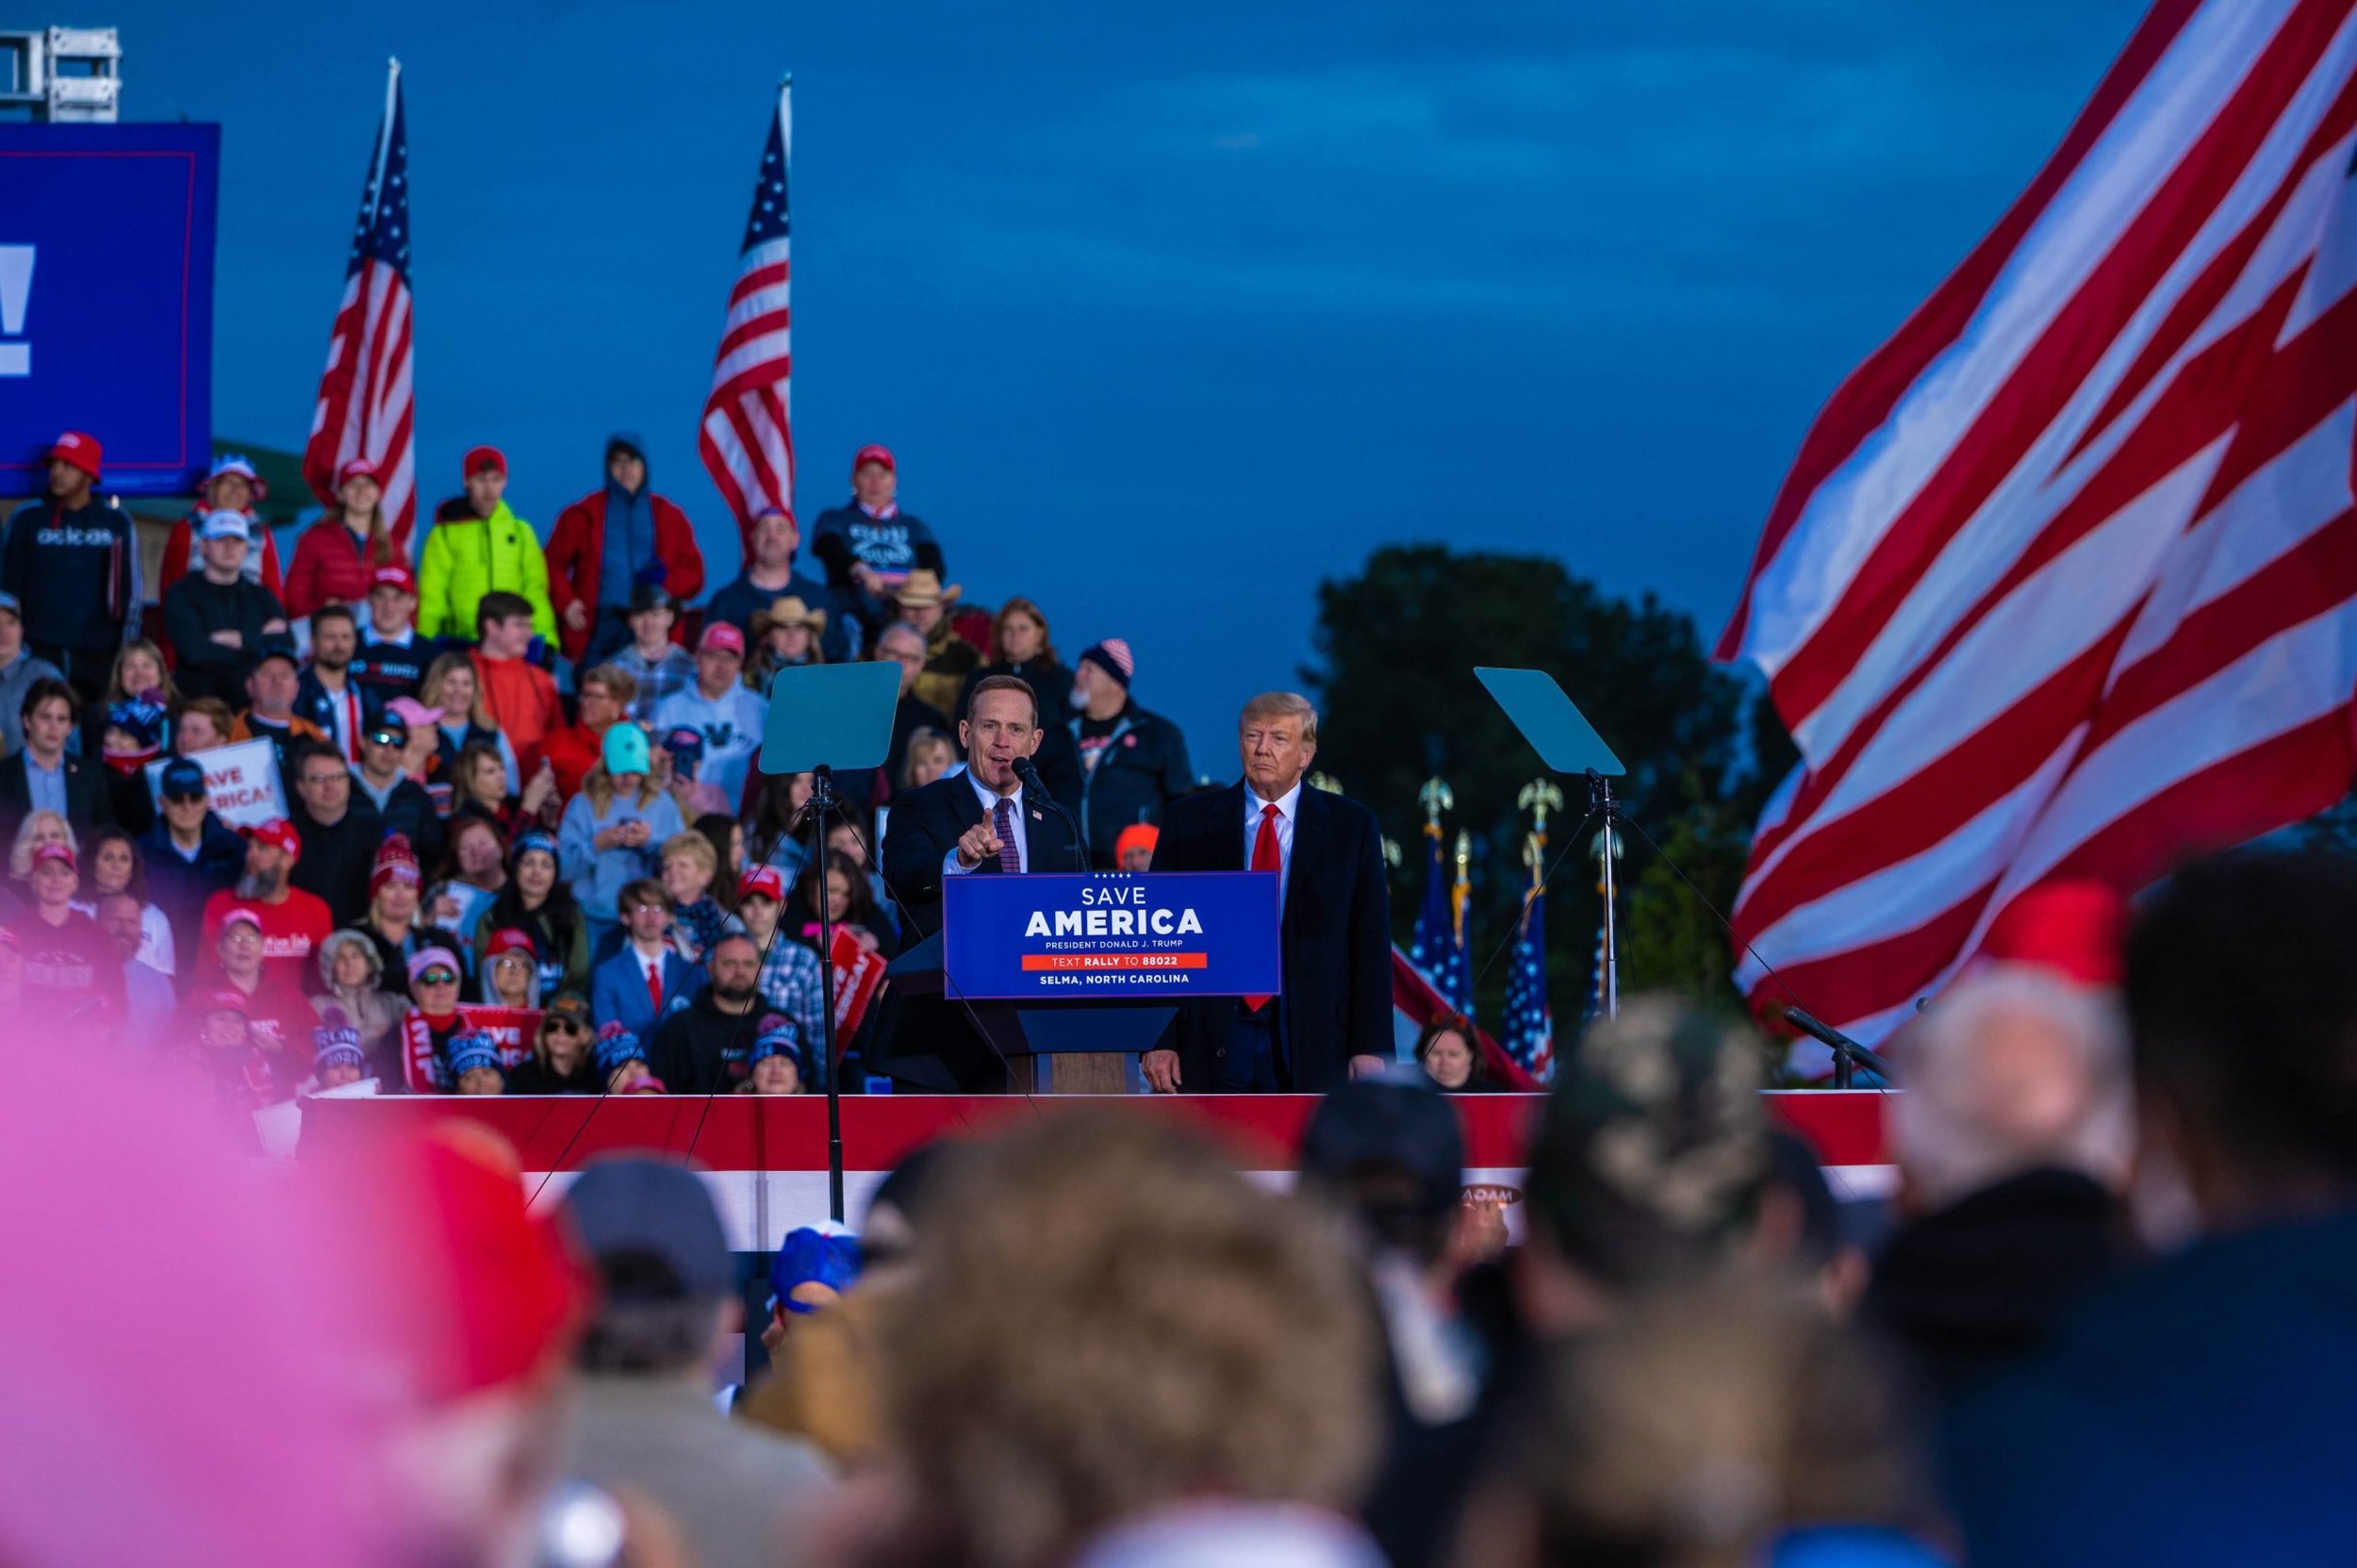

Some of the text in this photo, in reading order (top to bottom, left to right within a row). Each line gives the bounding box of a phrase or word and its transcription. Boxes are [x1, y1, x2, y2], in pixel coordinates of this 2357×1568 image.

[203, 767, 243, 788] AVE
[1081, 886, 1146, 905] SAVE
[1024, 908, 1204, 937] AMERICA
[1046, 941, 1096, 949] PRESIDENT
[1099, 940, 1139, 949] DONALD
[1152, 939, 1183, 948] TRUMP
[1052, 956, 1178, 966] TEXT RALLY TO 88022
[1040, 974, 1189, 985] SELMA, NORTH CAROLINA
